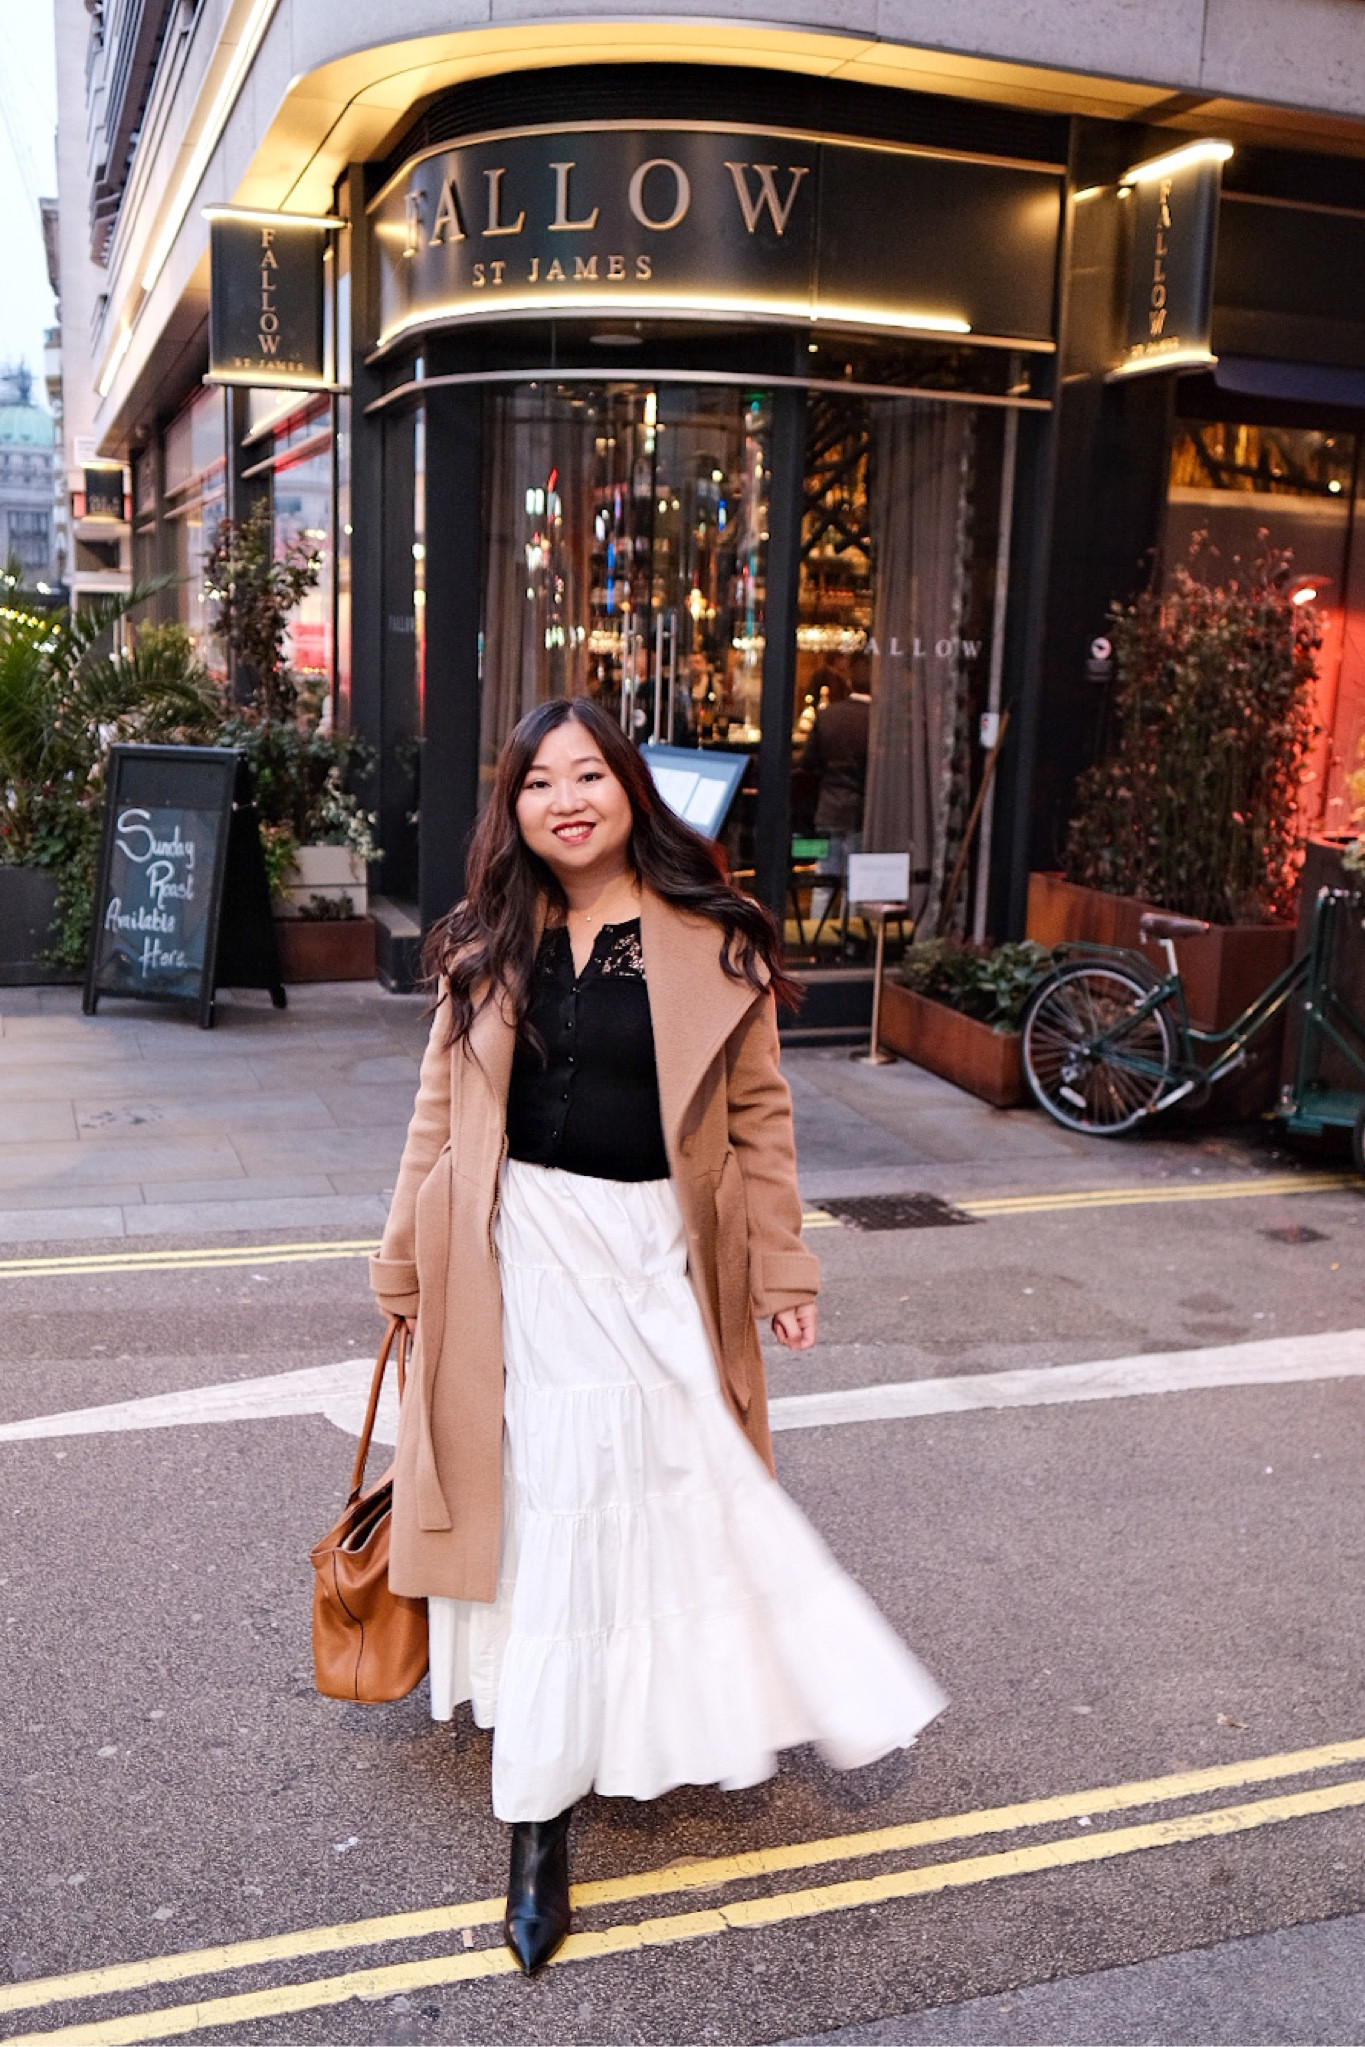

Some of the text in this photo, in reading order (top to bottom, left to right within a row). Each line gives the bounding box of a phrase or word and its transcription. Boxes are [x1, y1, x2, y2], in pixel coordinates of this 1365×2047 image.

[403, 158, 809, 257] FALLOW
[257, 228, 281, 355] FALLOW
[472, 254, 653, 288] ST JAMES
[116, 808, 195, 868] Sunday
[146, 860, 194, 909] Roast
